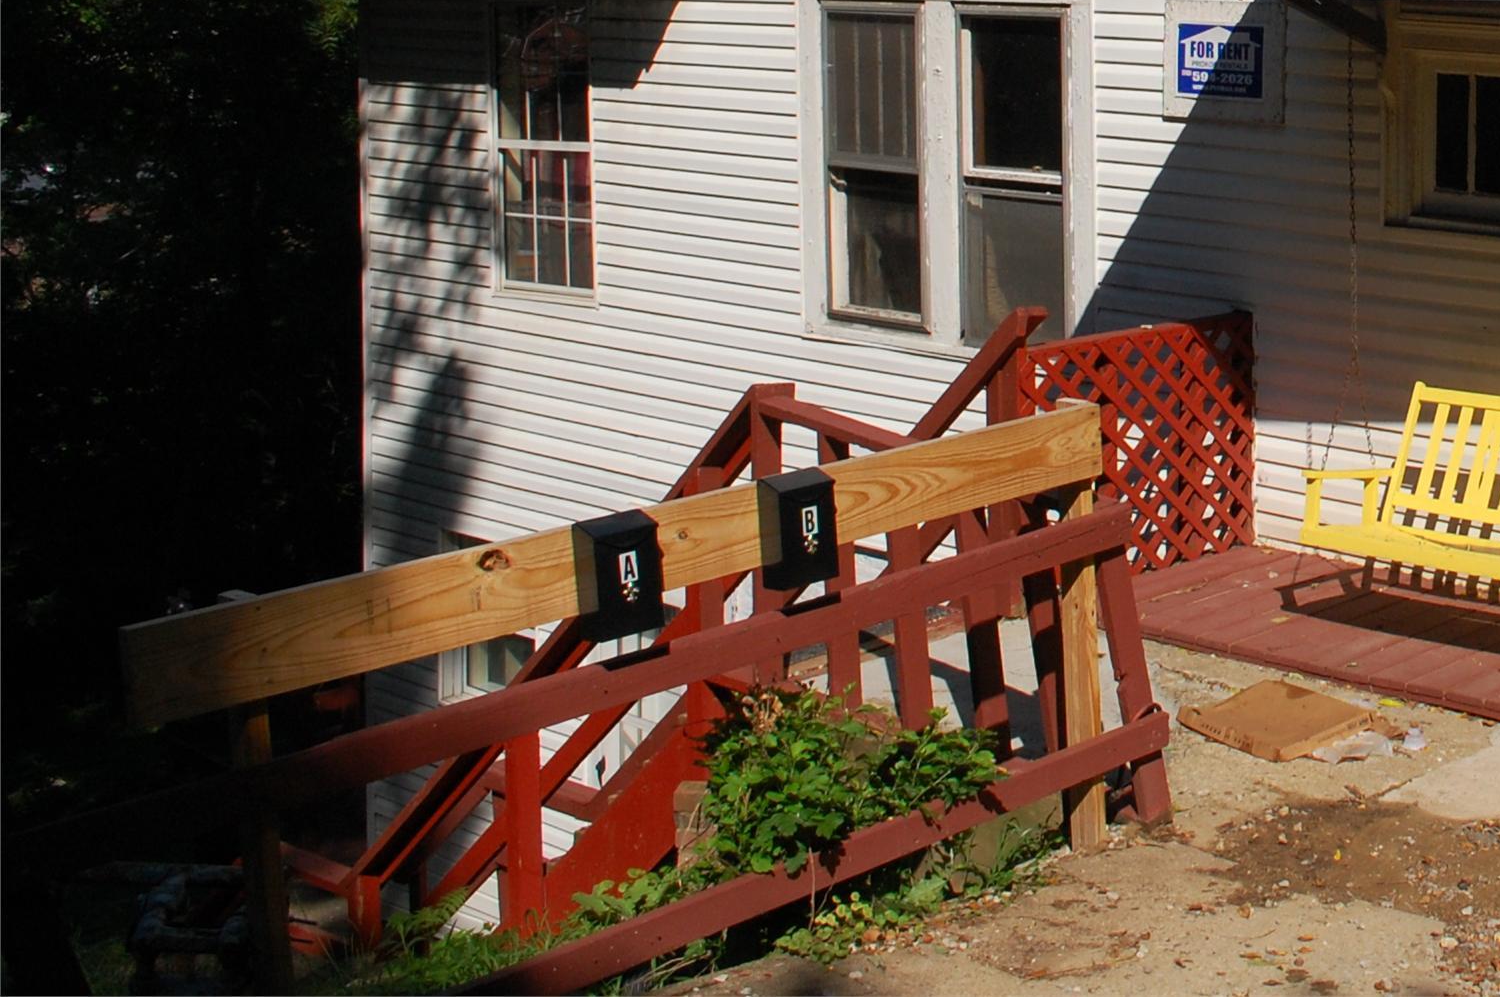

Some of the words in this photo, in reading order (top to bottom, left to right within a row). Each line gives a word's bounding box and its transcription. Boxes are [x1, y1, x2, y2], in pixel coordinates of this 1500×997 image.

[1190, 41, 1214, 58] FOR
[1218, 43, 1251, 61] RENT
[805, 510, 815, 533] B
[624, 555, 636, 580] A
